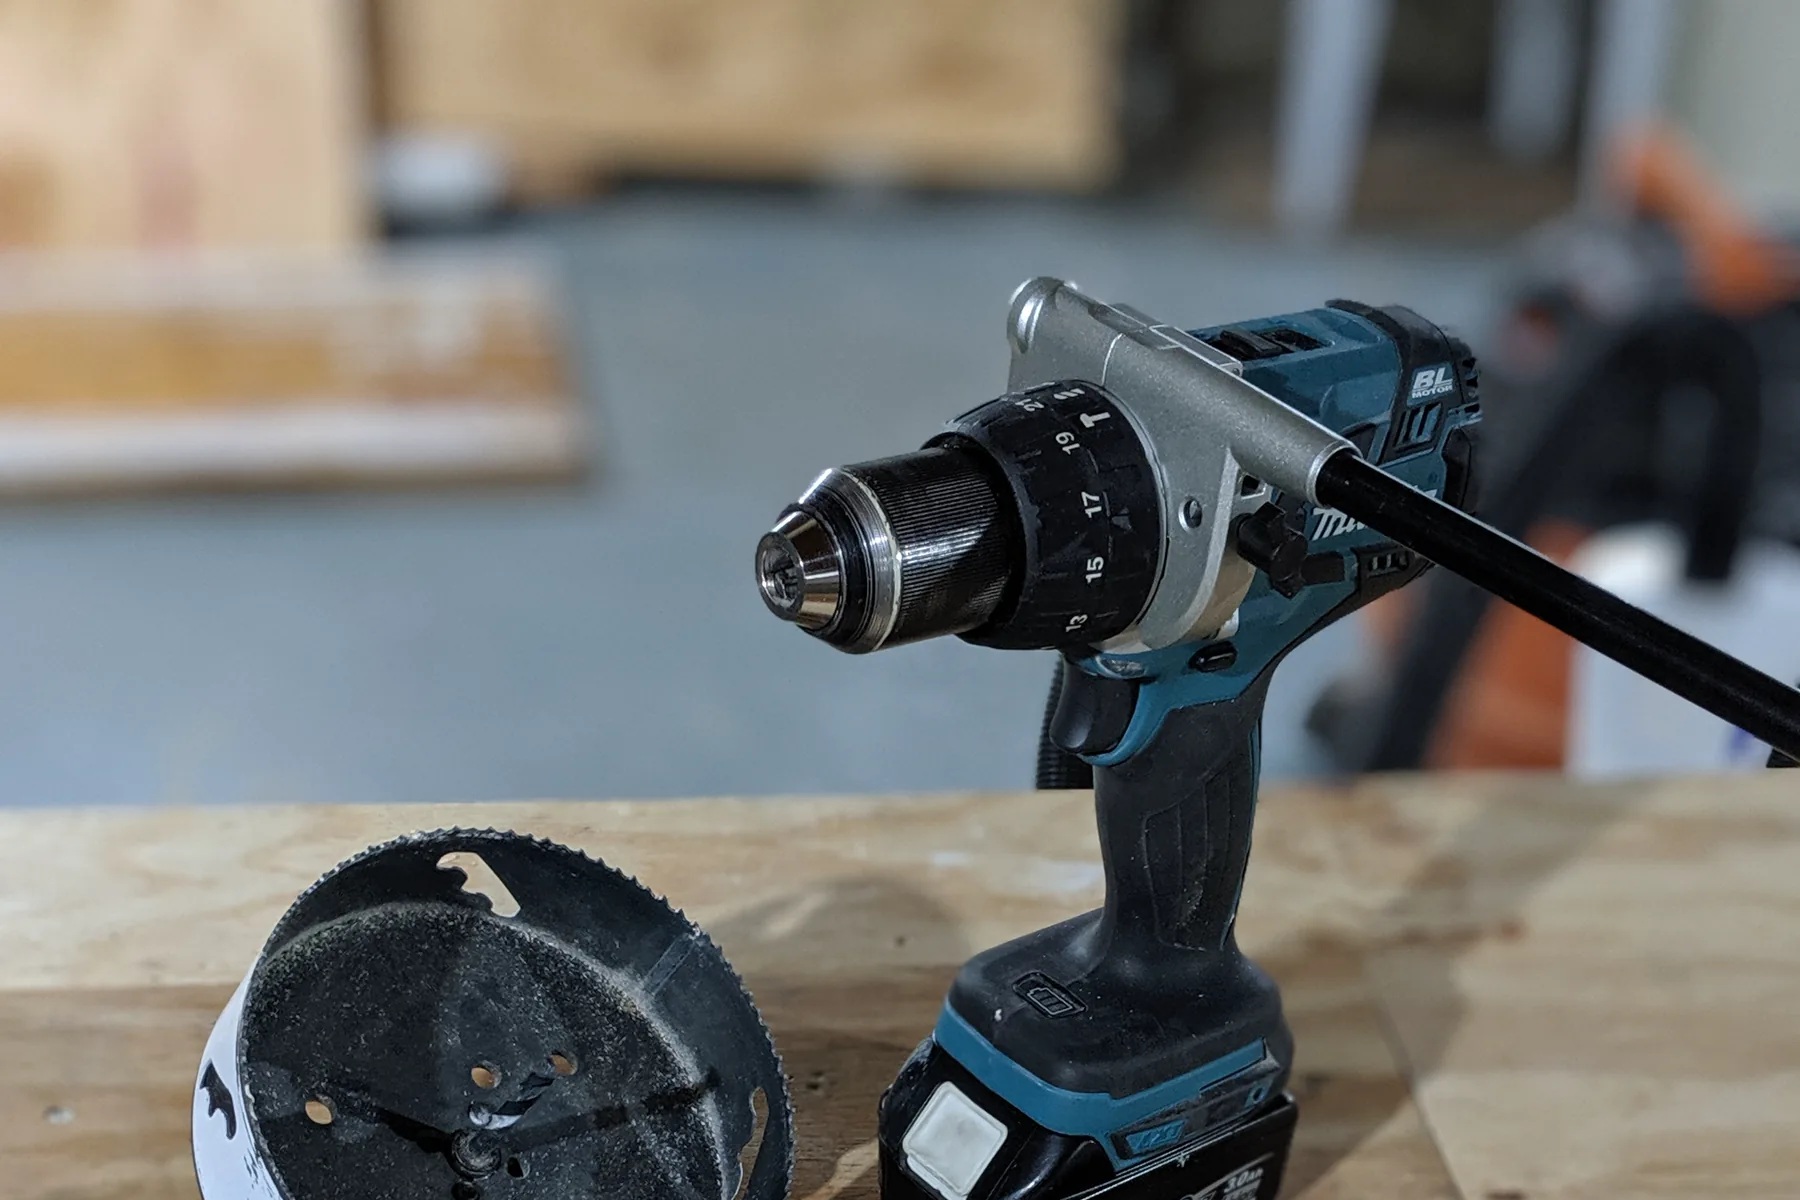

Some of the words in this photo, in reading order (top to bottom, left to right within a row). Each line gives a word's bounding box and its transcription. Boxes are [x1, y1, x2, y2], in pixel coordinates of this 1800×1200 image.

[1413, 367, 1453, 389] BL
[1412, 384, 1453, 399] MOTOR
[1015, 398, 1045, 412] 21
[1055, 431, 1081, 455] 19
[1081, 491, 1103, 518] 17
[1085, 556, 1104, 584] 15
[1065, 614, 1089, 633] 13
